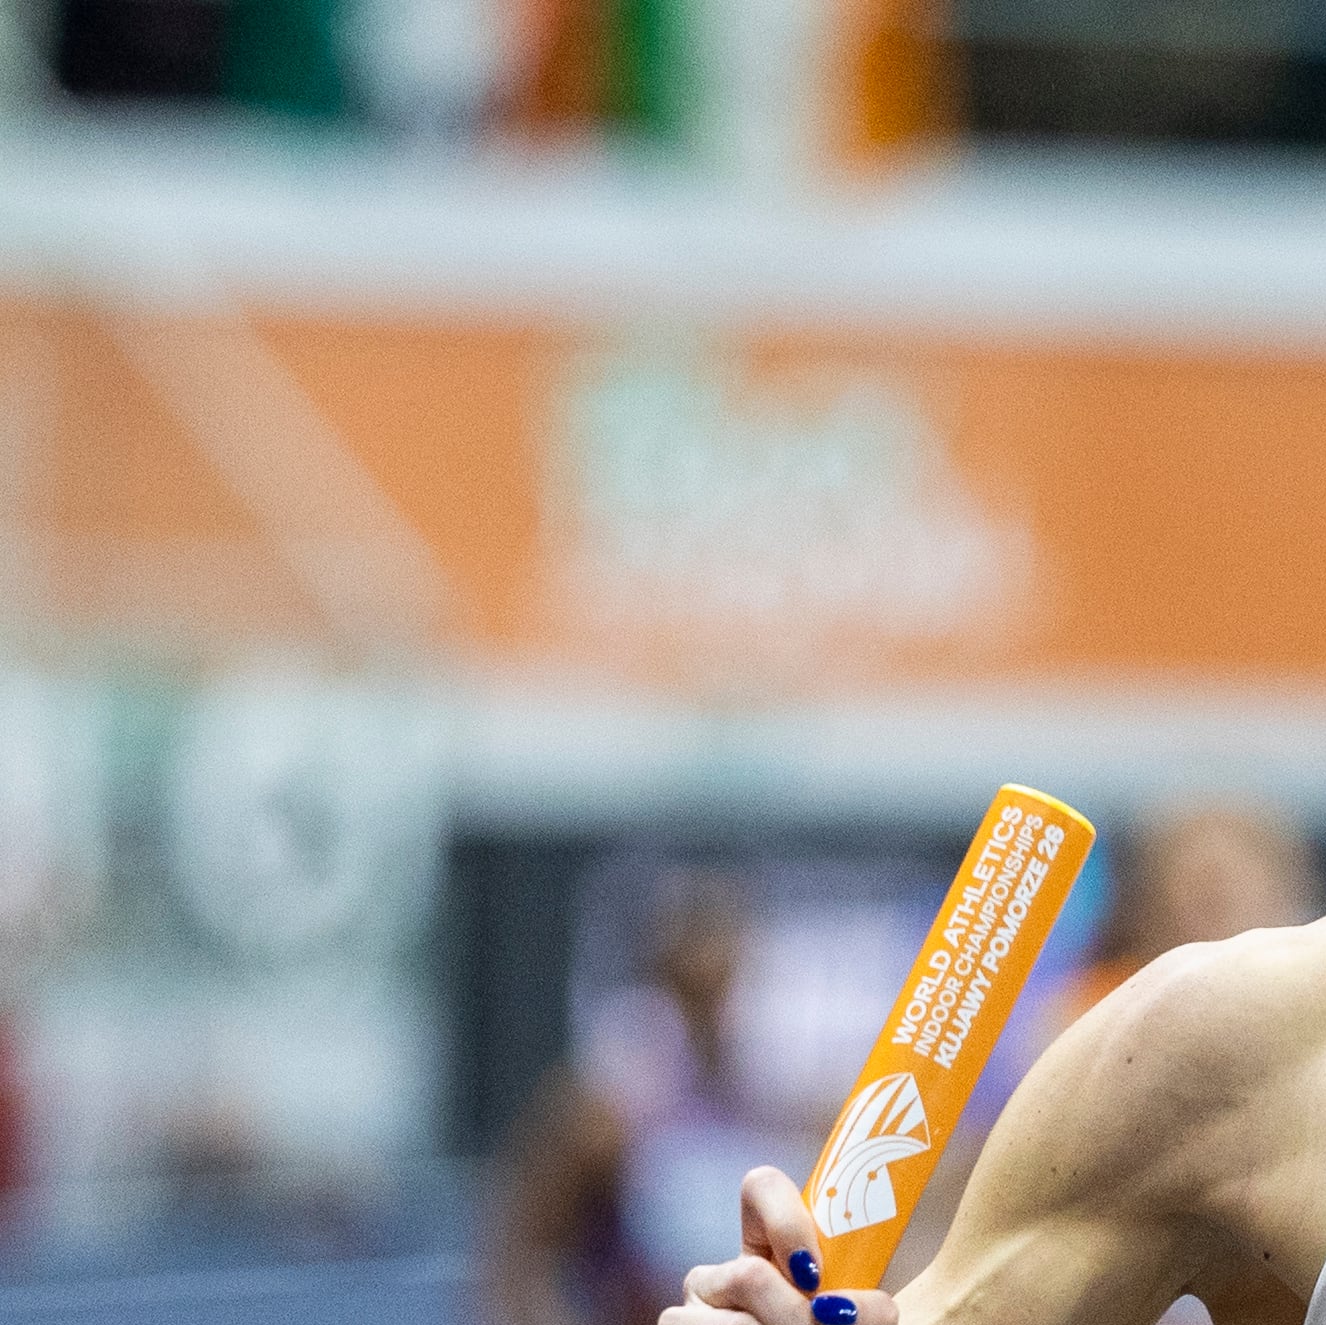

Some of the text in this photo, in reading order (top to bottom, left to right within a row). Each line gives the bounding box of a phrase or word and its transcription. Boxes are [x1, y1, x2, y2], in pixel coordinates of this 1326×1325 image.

[891, 804, 1023, 1045] WORLD ATHLETICS
[913, 814, 1043, 1057] INDOOR CHAMPIONSHIPS
[934, 824, 1065, 1070] KUJAWY POMORZE 26
